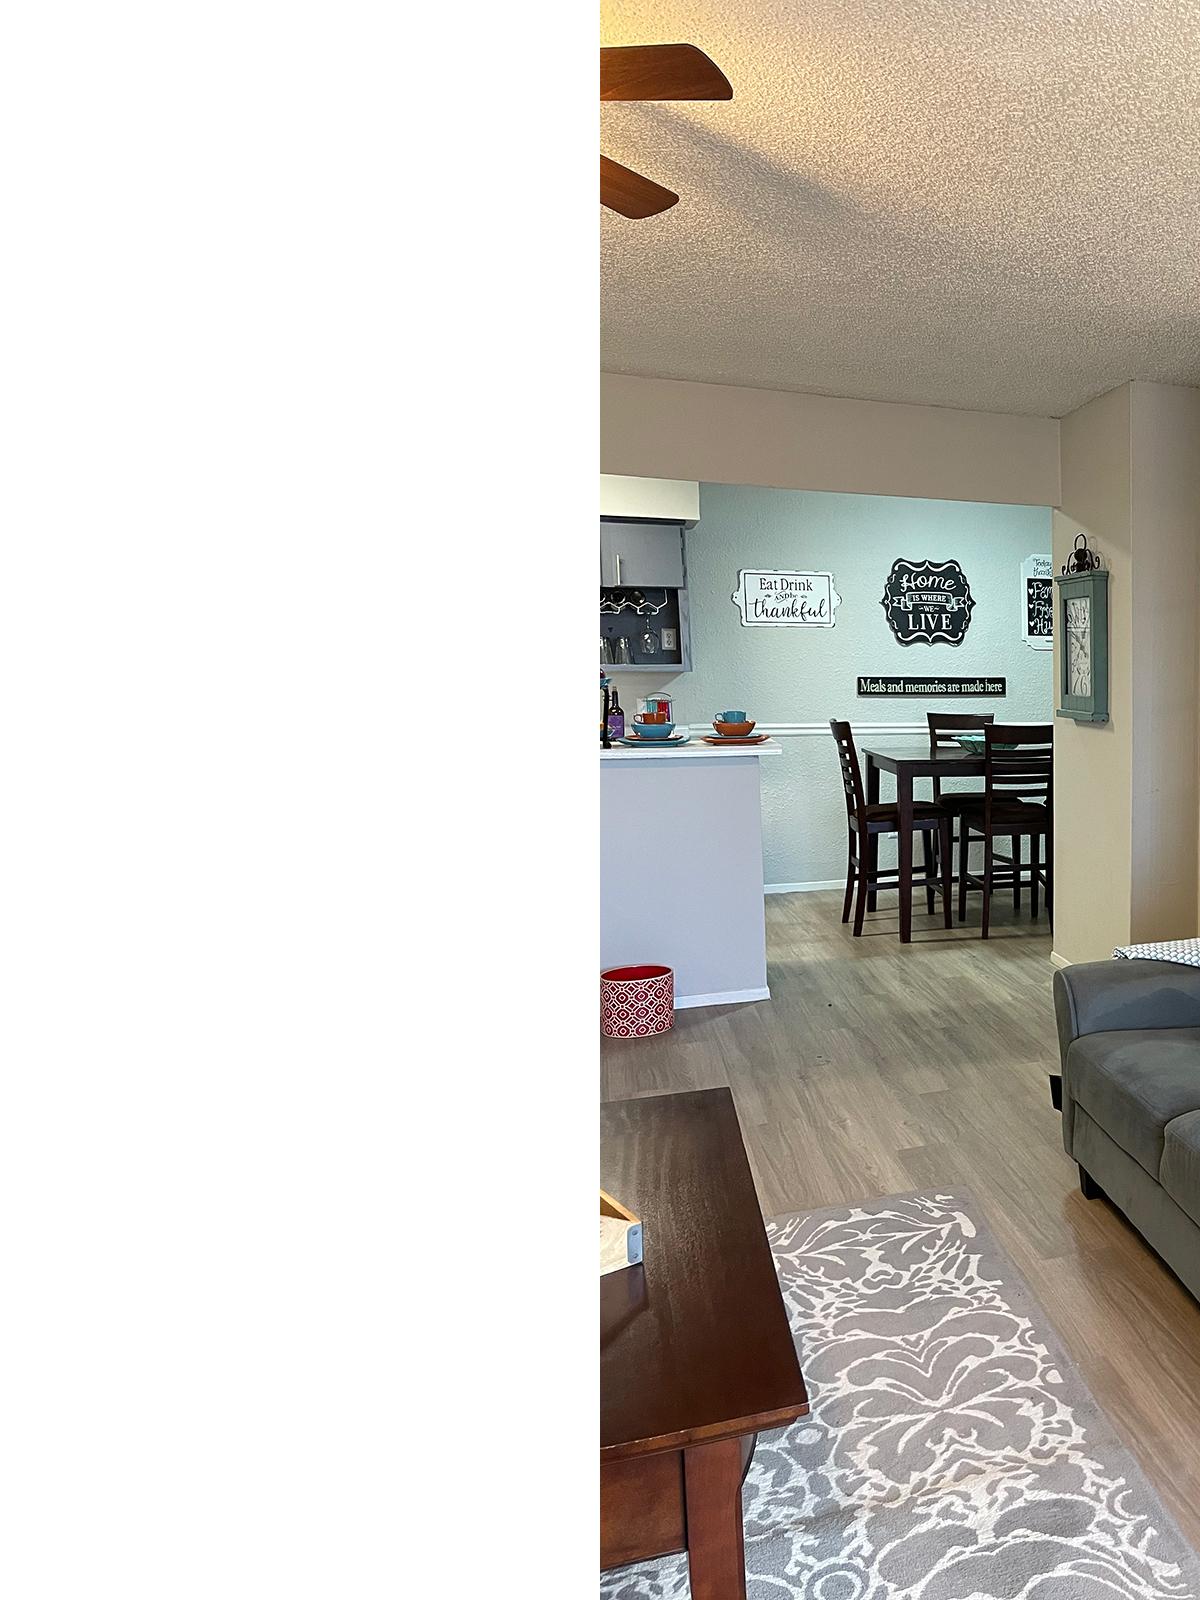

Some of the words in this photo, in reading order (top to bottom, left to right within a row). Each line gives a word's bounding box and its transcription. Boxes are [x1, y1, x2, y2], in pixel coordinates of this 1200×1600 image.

[760, 578, 778, 591] Eat
[780, 578, 813, 592] Drink
[900, 572, 956, 593] Home
[920, 594, 946, 602] WHERE
[749, 598, 827, 621] thankful
[908, 613, 952, 630] LIVE
[860, 678, 886, 692] Meals
[887, 680, 904, 692] and
[905, 680, 947, 692] memories
[947, 683, 960, 692] are
[961, 680, 984, 692] made
[985, 679, 1002, 692] here
